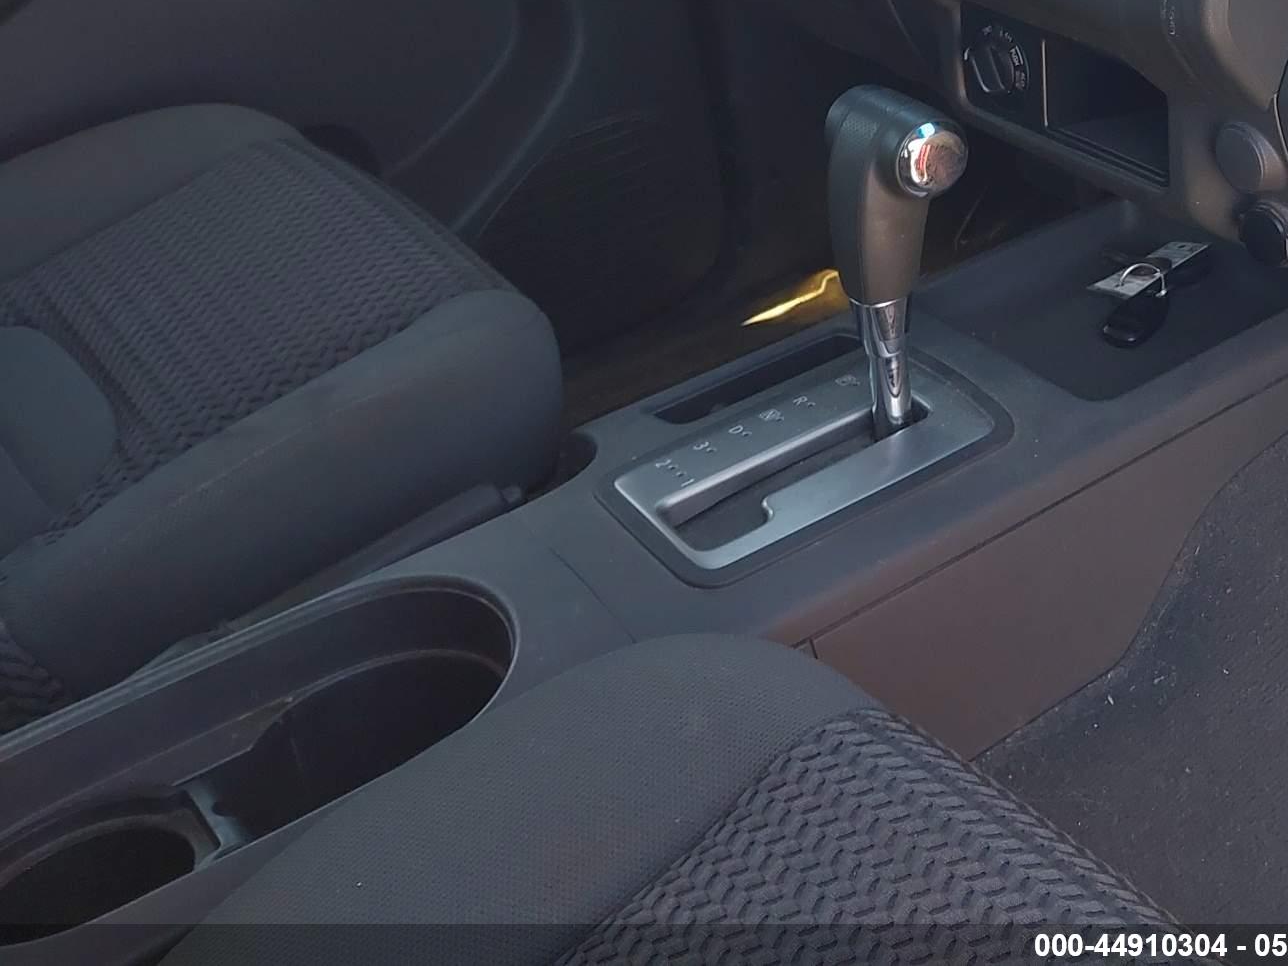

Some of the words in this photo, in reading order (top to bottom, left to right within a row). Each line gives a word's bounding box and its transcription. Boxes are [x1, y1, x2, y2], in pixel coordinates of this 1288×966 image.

[791, 395, 808, 407] R
[728, 425, 744, 434] D
[692, 441, 710, 451] 3
[655, 458, 672, 469] 2
